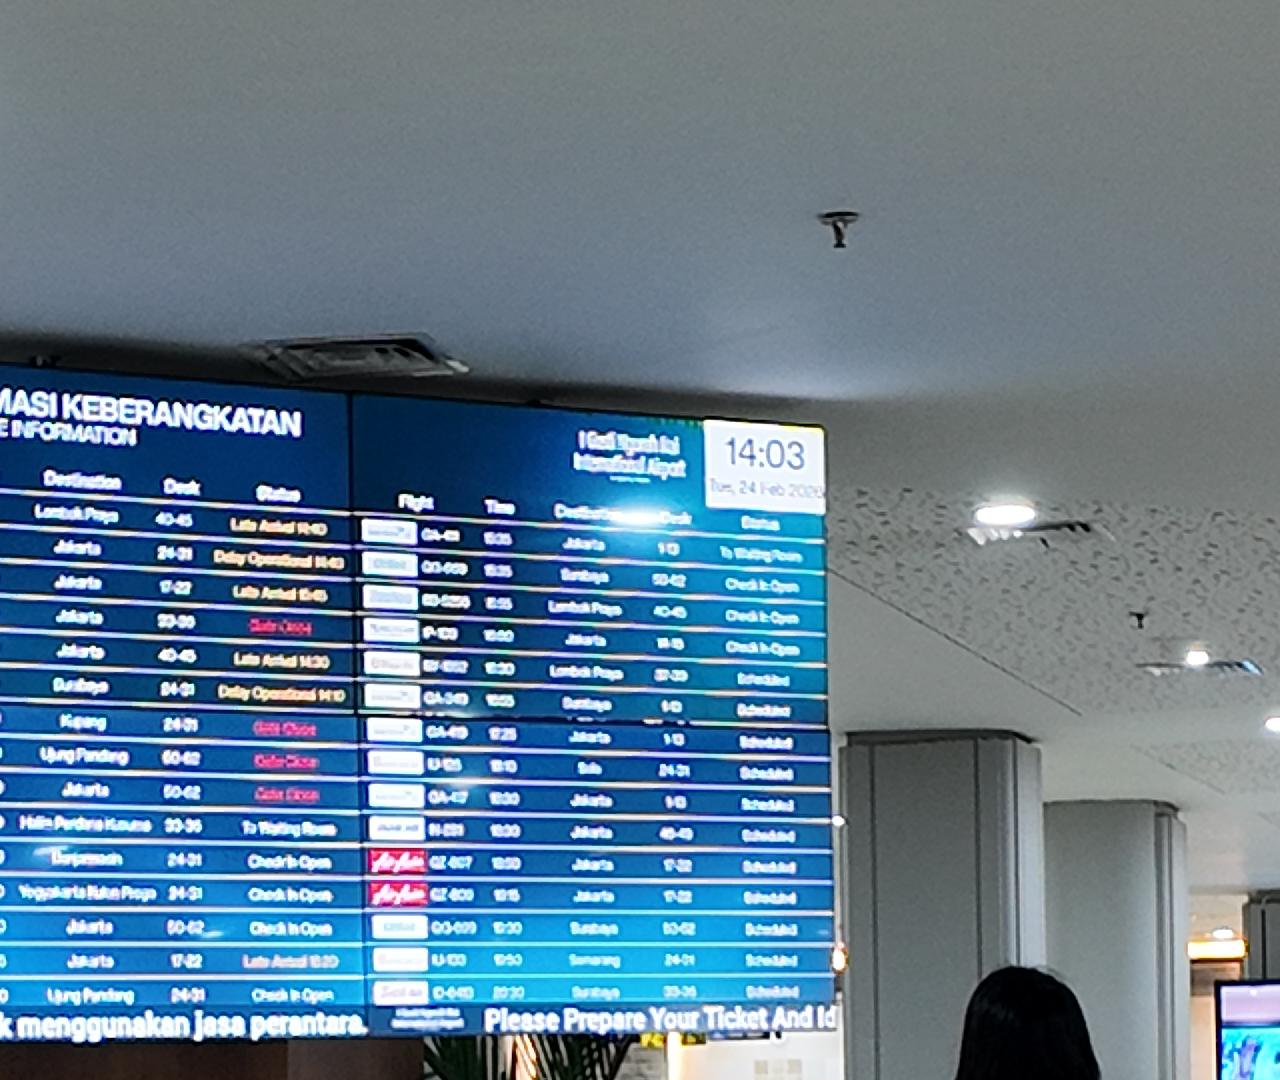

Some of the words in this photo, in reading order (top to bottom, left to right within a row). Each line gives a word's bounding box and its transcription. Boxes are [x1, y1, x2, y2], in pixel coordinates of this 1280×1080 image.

[62, 394, 301, 437] KEBERANGKATAN
[11, 420, 137, 446] INFORMATION
[727, 438, 804, 470] 14:03
[44, 470, 122, 490] Destination
[164, 478, 200, 495] Desk
[739, 480, 756, 494] 24
[256, 485, 300, 502] Status
[398, 494, 434, 512] Flight
[485, 500, 515, 514] Time
[16, 1010, 190, 1042] menggunakan
[193, 1010, 246, 1041] jasa
[250, 1012, 368, 1041] perantara.
[485, 1008, 560, 1037] Please
[564, 1008, 647, 1037] Prepare
[648, 1007, 704, 1035] Your
[704, 1006, 768, 1030] Ticket
[772, 1006, 815, 1033] And
[818, 1006, 838, 1028] Id
